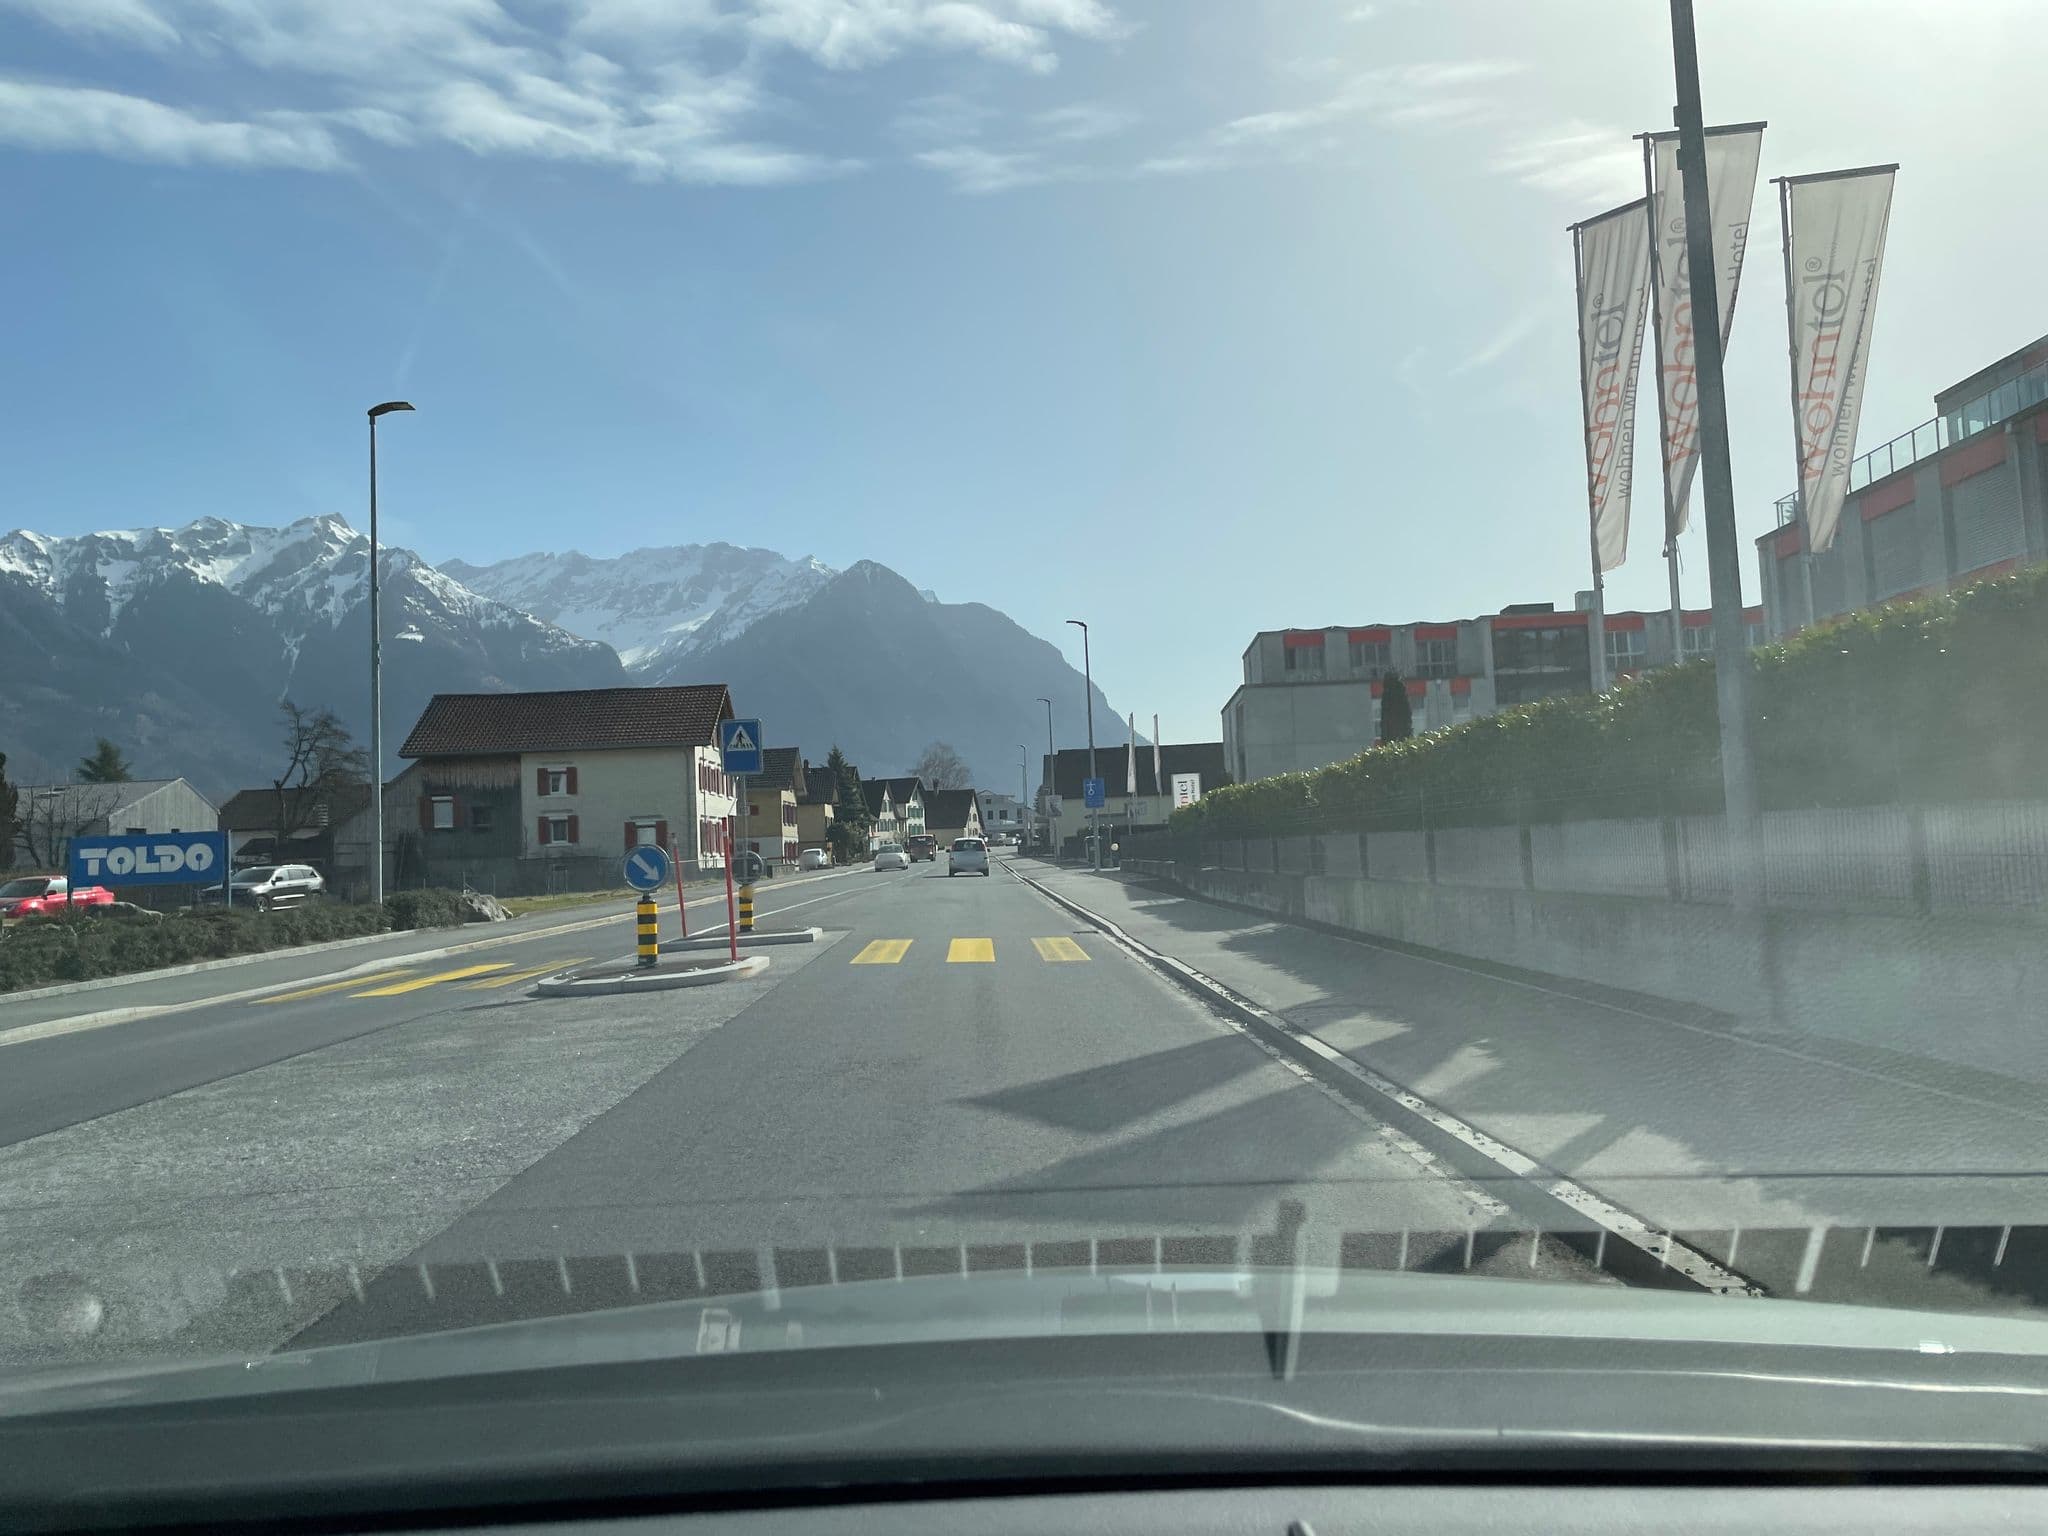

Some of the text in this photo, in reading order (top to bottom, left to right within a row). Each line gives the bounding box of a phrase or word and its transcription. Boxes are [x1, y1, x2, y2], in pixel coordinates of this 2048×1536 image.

[1616, 419, 1634, 499] wohnen
[1832, 393, 1854, 477] wohnen
[80, 843, 213, 876] TOLDO
